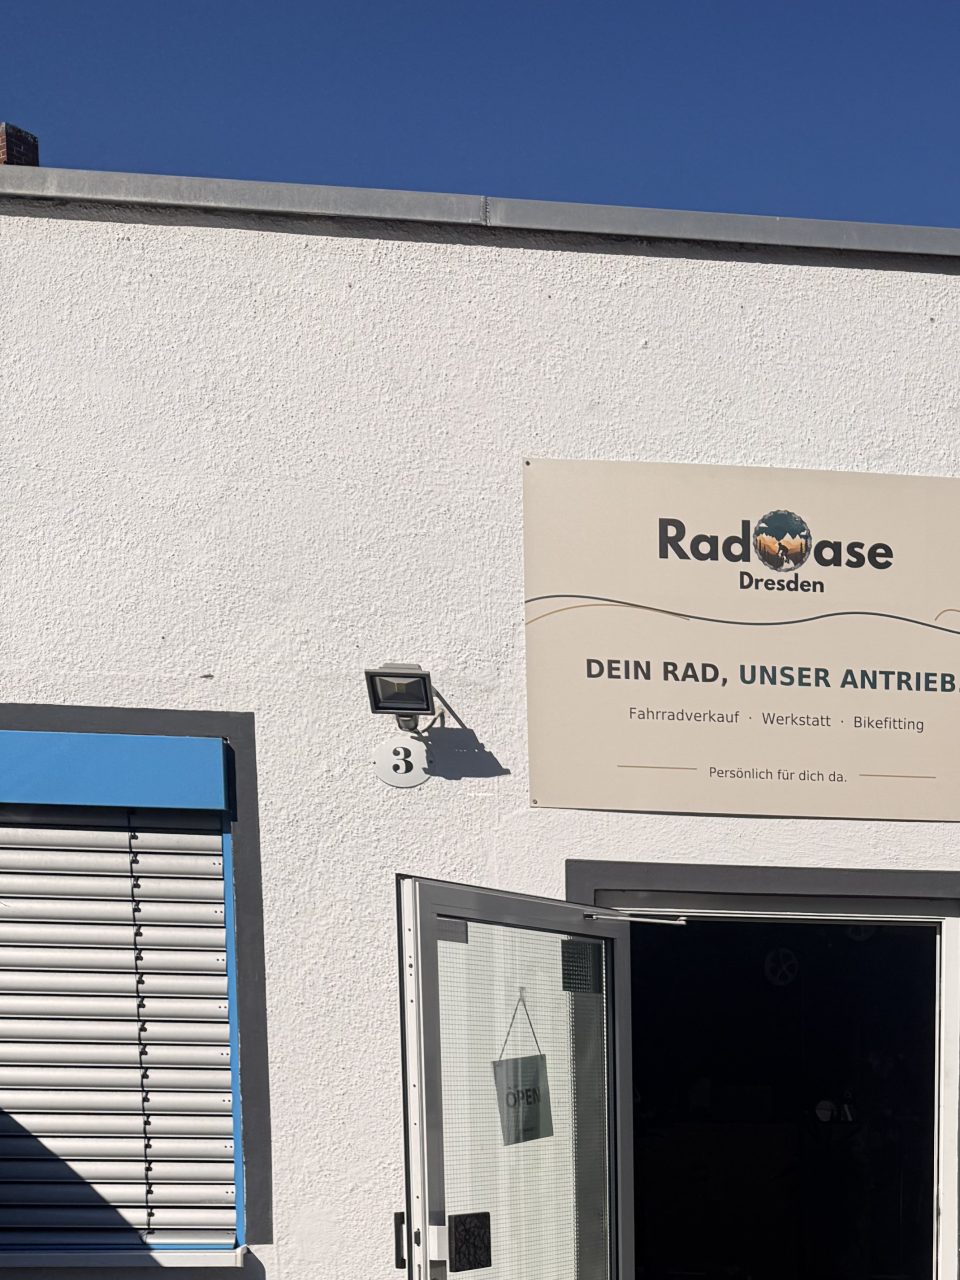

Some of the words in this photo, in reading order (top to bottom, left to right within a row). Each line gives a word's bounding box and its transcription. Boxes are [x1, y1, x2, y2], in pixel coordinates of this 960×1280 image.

[740, 569, 824, 592] Dresden
[587, 659, 650, 680] DEIN
[663, 662, 727, 687] RAD,
[740, 665, 831, 687] UNSER
[630, 707, 739, 723] Fahrradverkauf
[762, 713, 831, 726] Werkstatt
[854, 716, 923, 733] Bikefitting
[392, 747, 413, 774] 3
[710, 767, 772, 779] Persönlich
[778, 769, 795, 780] für
[799, 770, 824, 781] dich
[829, 771, 846, 782] da.
